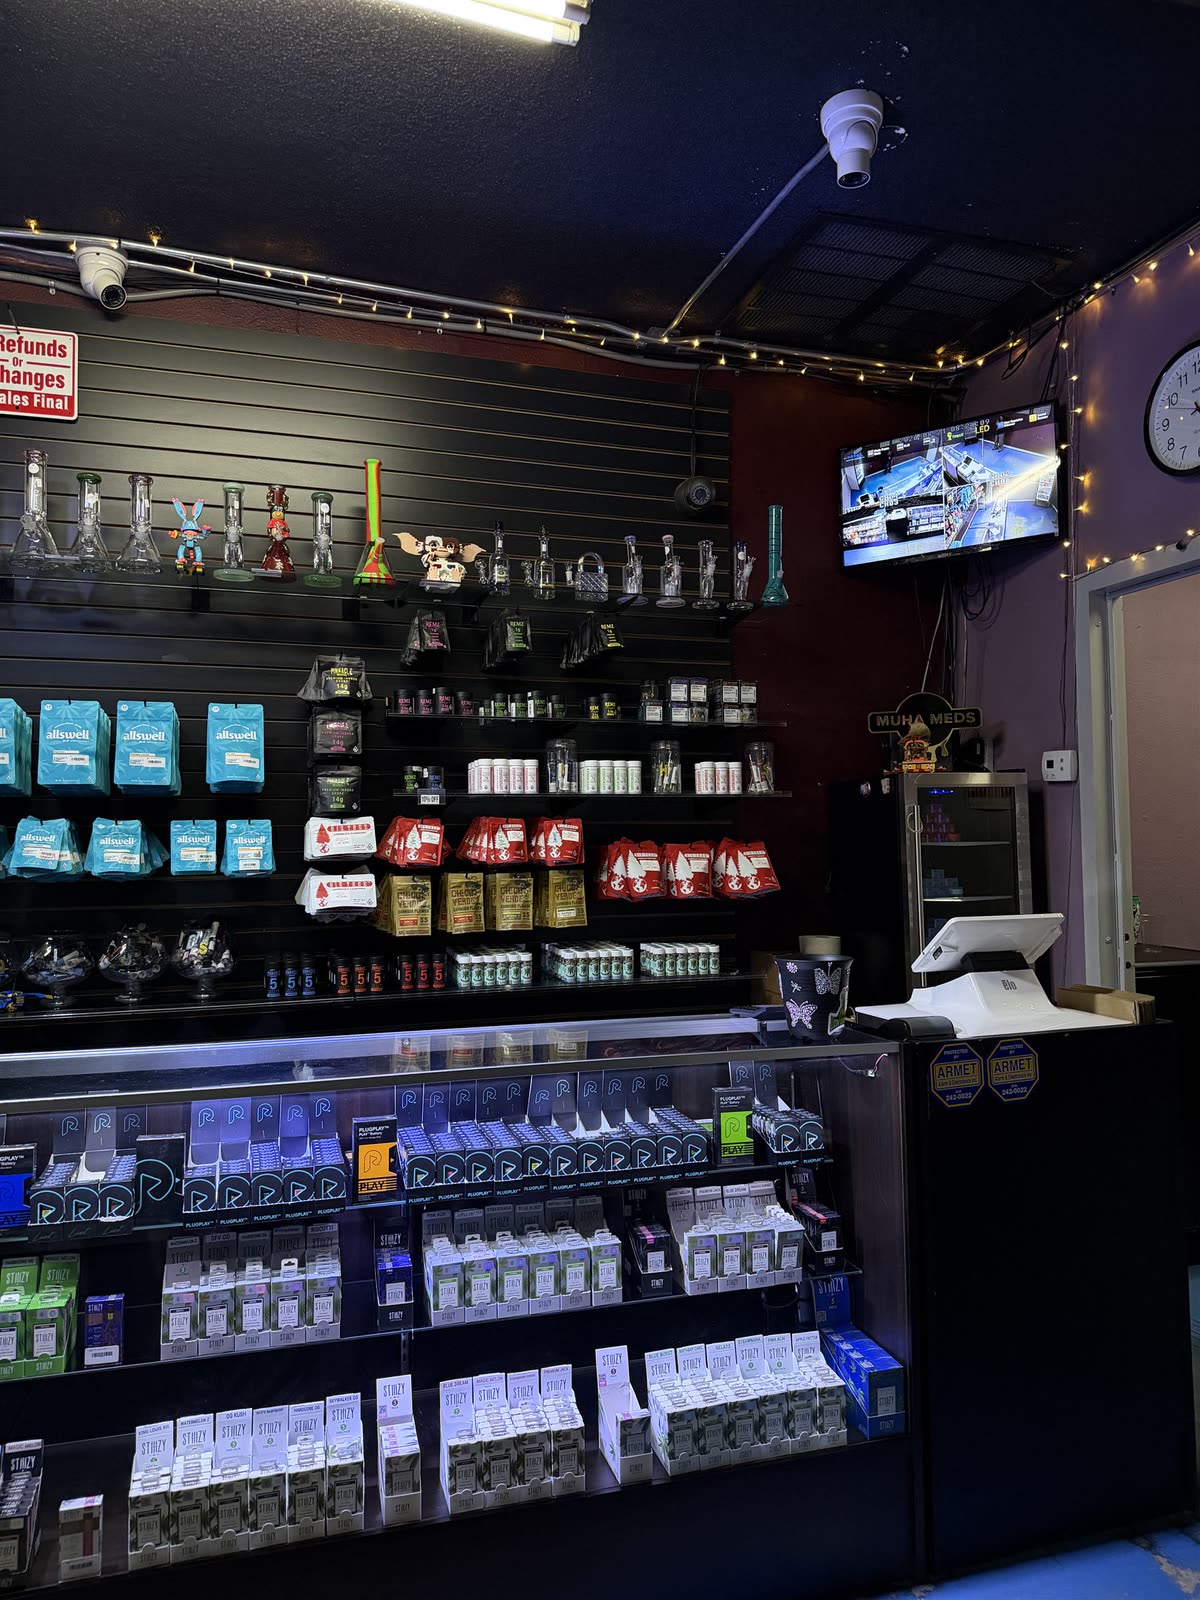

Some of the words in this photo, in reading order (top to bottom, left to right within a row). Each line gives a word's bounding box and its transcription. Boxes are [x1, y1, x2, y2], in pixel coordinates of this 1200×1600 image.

[12, 357, 23, 367] Or
[1177, 372, 1188, 388] 11
[34, 394, 69, 410] Final
[1167, 392, 1178, 408] 10
[1161, 418, 1170, 431] 9
[1167, 437, 1175, 451] 8
[1179, 445, 1188, 460] 7
[930, 712, 976, 725] MEDS
[46, 729, 90, 740] allswell
[123, 731, 166, 742] allswell
[215, 729, 257, 741] allswell
[20, 833, 56, 843] allswell
[100, 836, 135, 846] allswell
[177, 835, 210, 844] allswell
[233, 836, 266, 845] allswell
[305, 975, 313, 988] 5
[340, 974, 348, 986] 5
[358, 973, 365, 985] 5
[374, 972, 381, 984] 5
[404, 970, 412, 982] 5
[420, 969, 428, 981] 5
[435, 969, 443, 981] 5
[269, 977, 278, 990] 5
[288, 977, 296, 989] 5
[937, 1063, 977, 1079] ARMET
[994, 1058, 1032, 1073] ARMET
[945, 1092, 972, 1101] 242-0022
[1001, 1087, 1027, 1096] 242-0022
[722, 1146, 744, 1155] PLAY
[359, 1180, 384, 1192] PLAY
[602, 1353, 623, 1366] STIIIZY
[383, 1382, 406, 1397] STIIIZY
[513, 1385, 534, 1399] STIIIZY
[546, 1379, 567, 1393] STIIIZY
[445, 1392, 467, 1407] STIIIZY
[478, 1387, 500, 1402] STIIIZY
[331, 1407, 355, 1422] STIIIZY
[221, 1424, 246, 1439] STIIIZY
[258, 1421, 283, 1436] STIIIZY
[294, 1418, 318, 1434] STIIIZY
[182, 1430, 207, 1446] STIIIZY
[141, 1439, 167, 1455] STIIIZY
